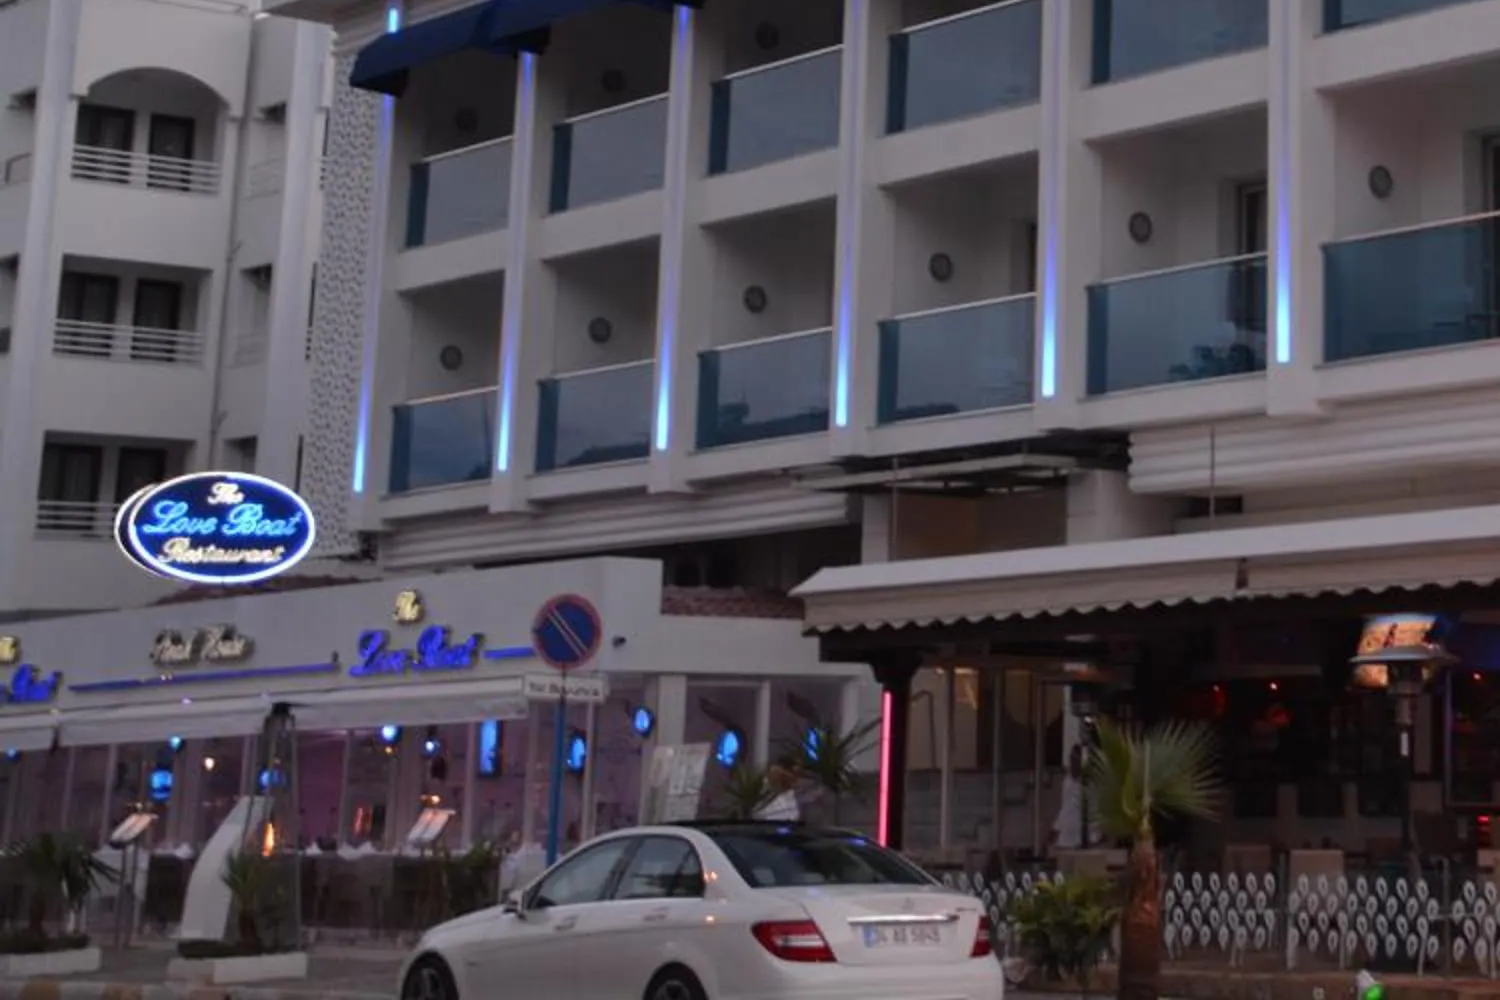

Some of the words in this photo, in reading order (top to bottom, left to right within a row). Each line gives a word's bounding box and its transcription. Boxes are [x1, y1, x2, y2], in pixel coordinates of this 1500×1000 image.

[207, 482, 245, 504] The
[143, 500, 218, 534] Love
[221, 503, 303, 536] Boat
[157, 536, 286, 564] Restaurant
